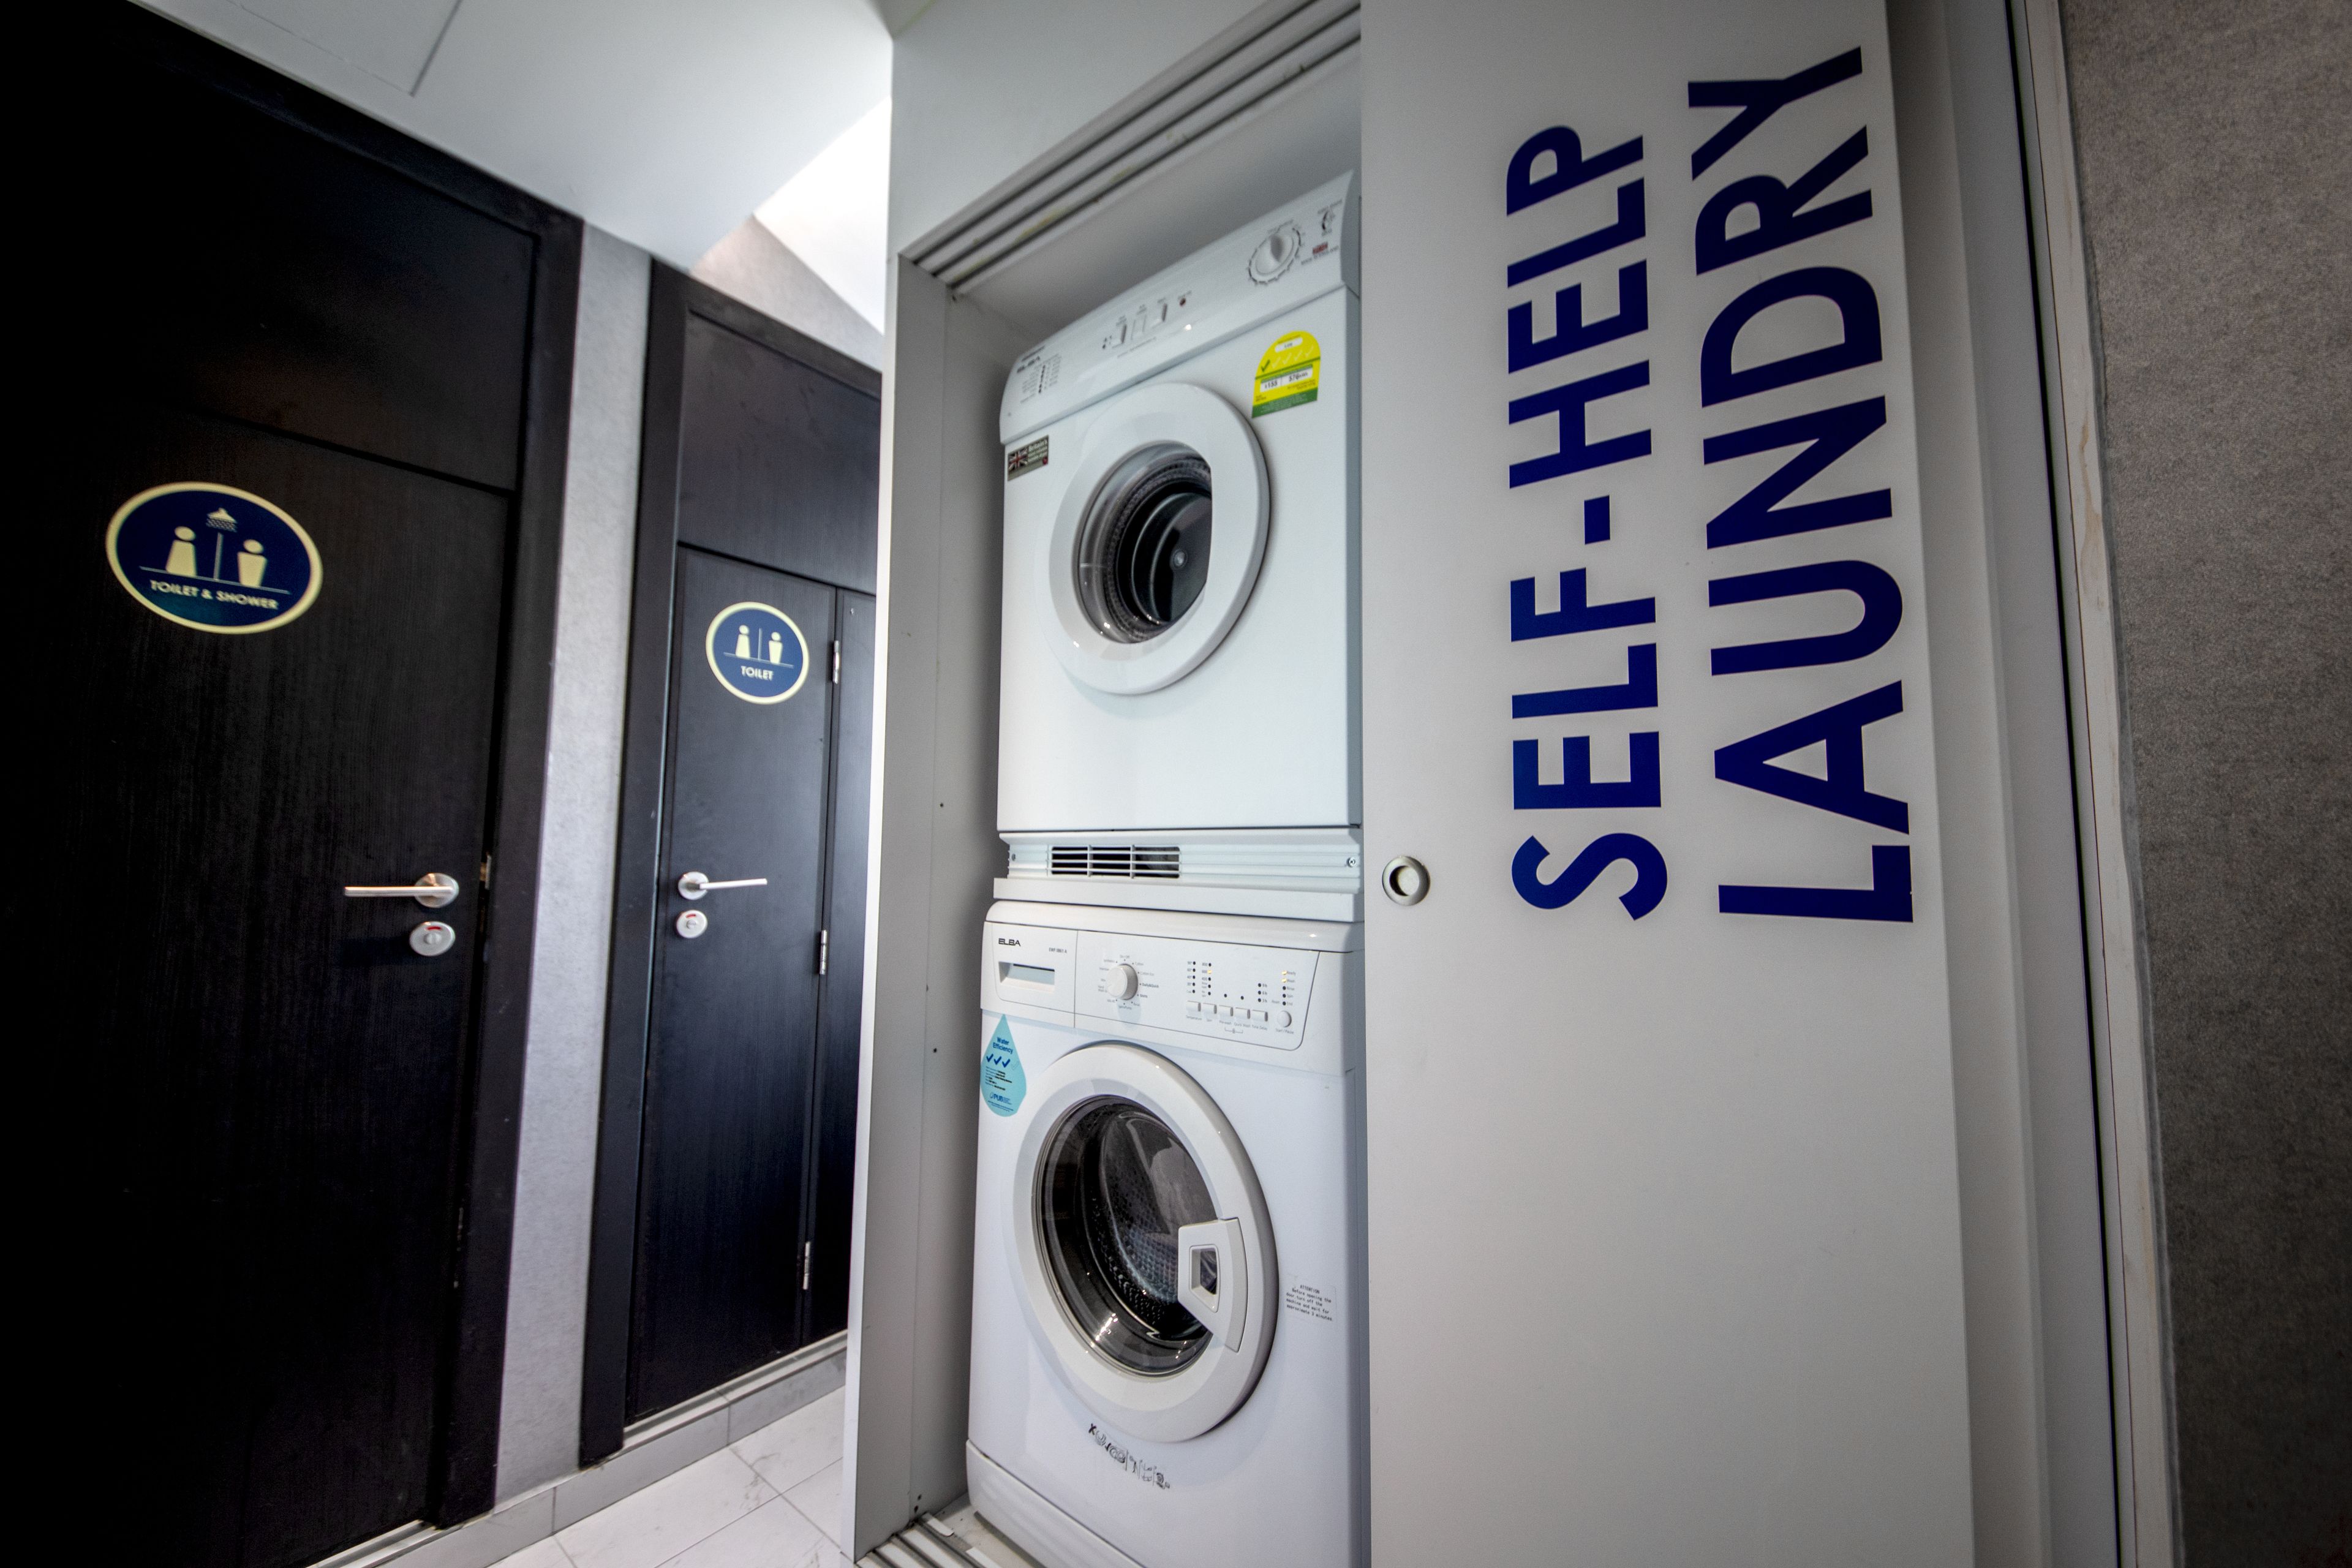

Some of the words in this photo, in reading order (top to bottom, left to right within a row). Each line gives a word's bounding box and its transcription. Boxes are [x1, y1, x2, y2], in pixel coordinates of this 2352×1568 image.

[1688, 46, 1913, 922] LAUNDRY
[1507, 126, 1668, 921] SELF-HELP
[149, 579, 199, 597] TOILET
[201, 589, 213, 600] &
[216, 590, 279, 609] SHOWER
[741, 666, 774, 681] TOILET
[998, 938, 1021, 947] ELBA
[997, 1036, 1009, 1046] Water
[993, 1042, 1014, 1054] Efficiency
[993, 1093, 1003, 1102] PUB
[1300, 1284, 1320, 1294] ATTENTION
